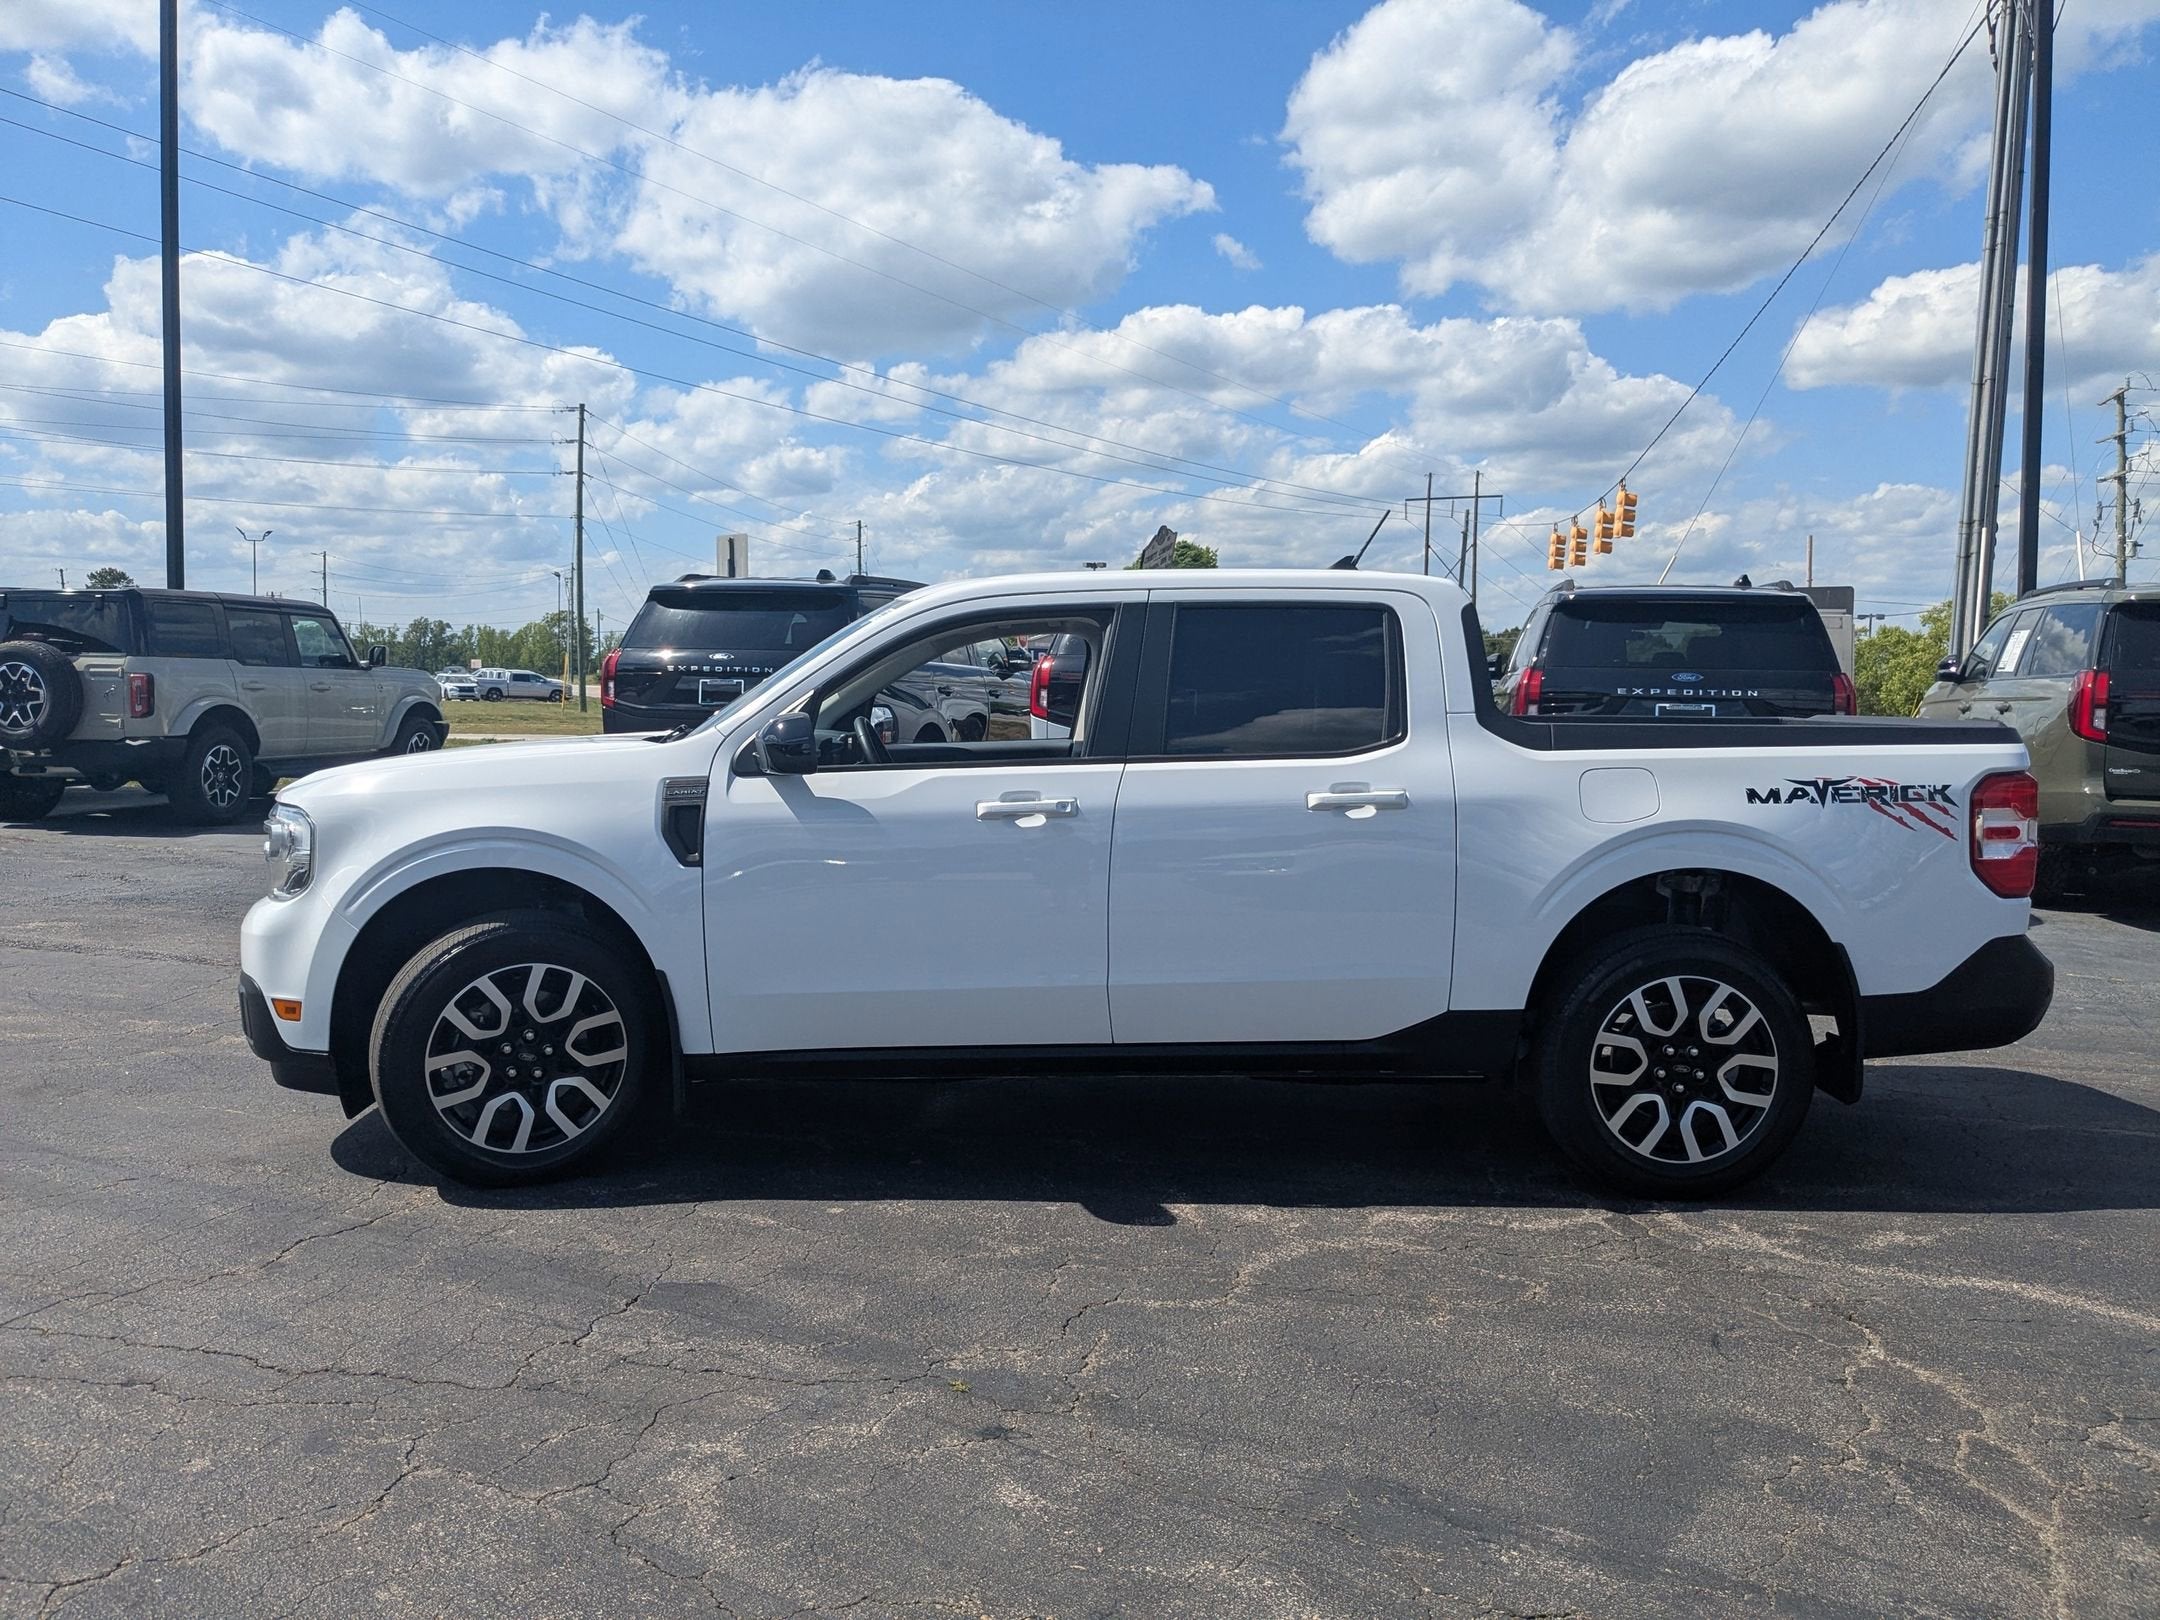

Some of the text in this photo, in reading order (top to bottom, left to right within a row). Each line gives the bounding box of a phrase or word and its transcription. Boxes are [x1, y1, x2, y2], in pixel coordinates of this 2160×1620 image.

[666, 665, 773, 673] EXPEDITION
[1616, 687, 1758, 697] EXPEDITION
[1745, 777, 1960, 809] MAVERICK
